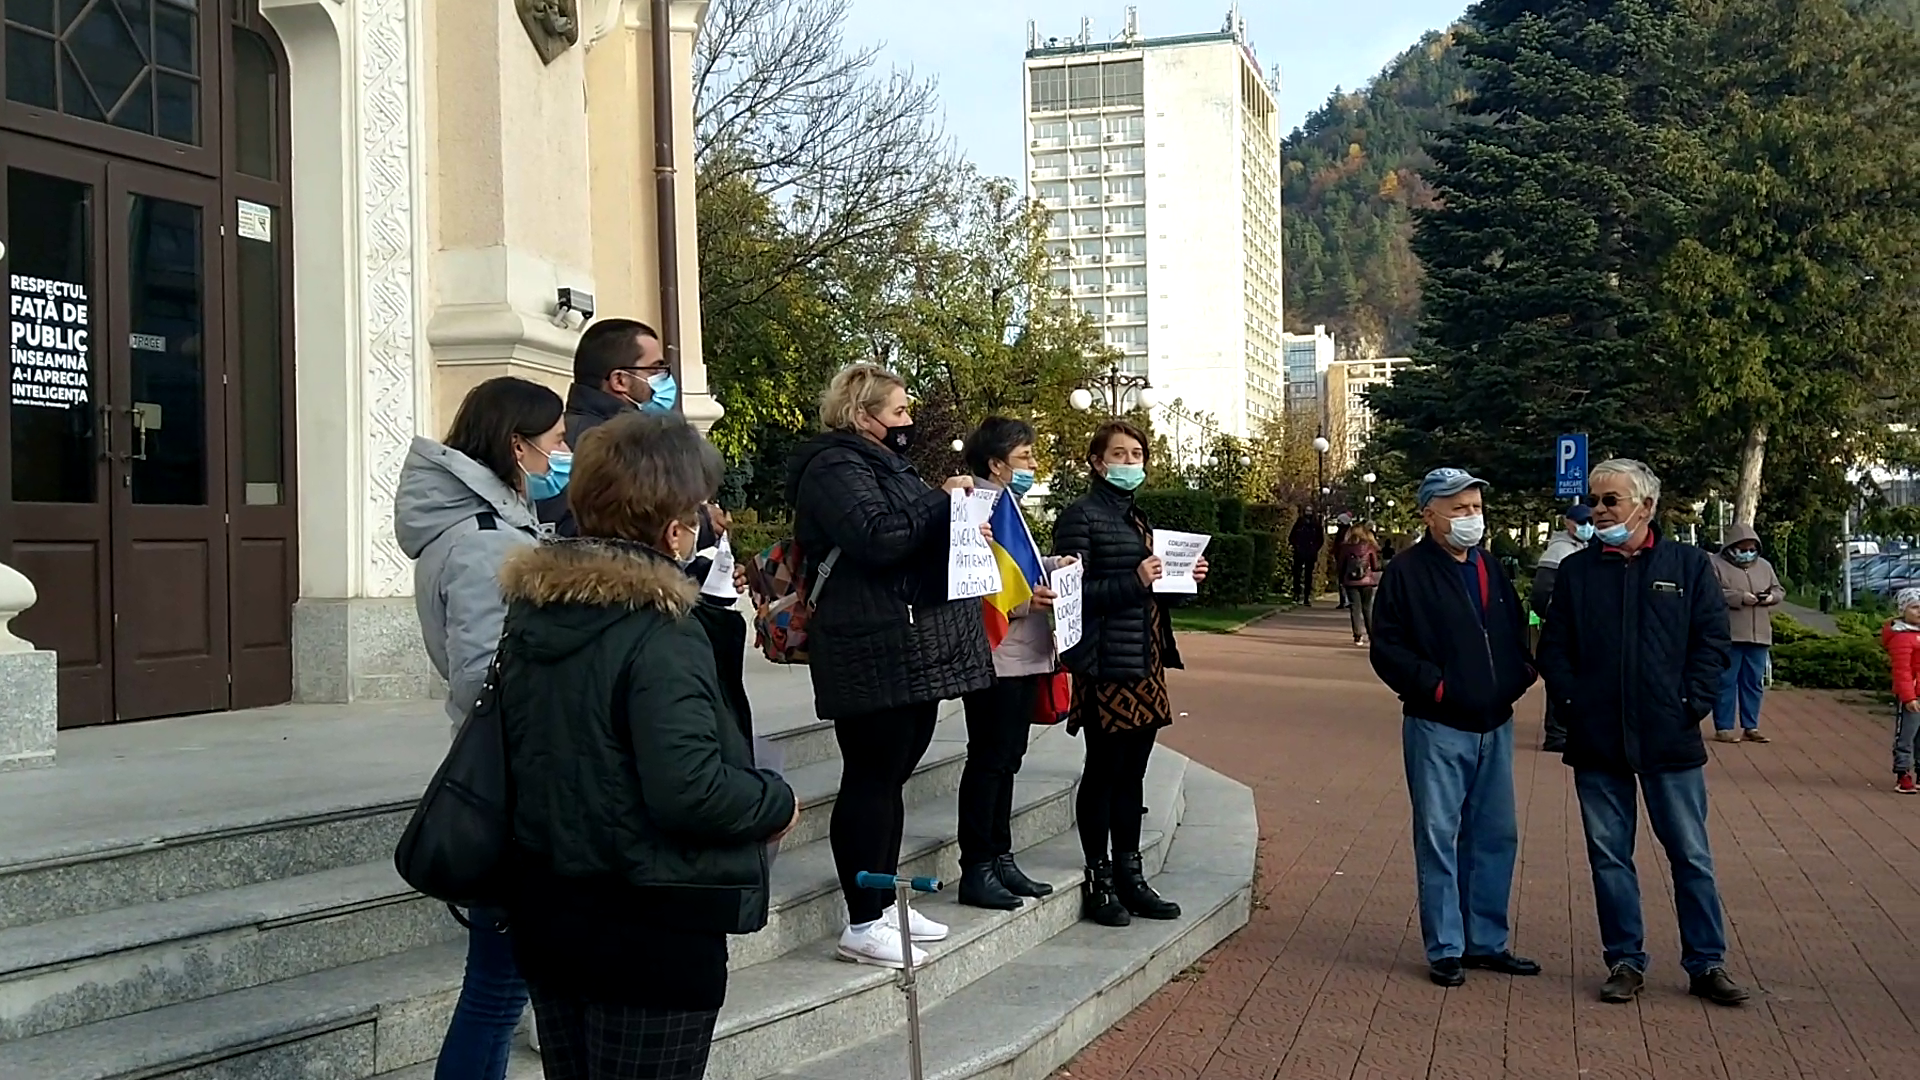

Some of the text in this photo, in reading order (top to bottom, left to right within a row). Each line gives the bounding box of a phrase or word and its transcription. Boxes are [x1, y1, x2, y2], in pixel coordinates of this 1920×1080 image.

[10, 274, 87, 300] RESPECTUL
[62, 302, 88, 325] DE
[11, 321, 88, 352] PUBLIC
[10, 344, 88, 371] ÎNSEAMNĂ
[12, 366, 88, 387] A-I APRECIA
[1560, 439, 1576, 475] P
